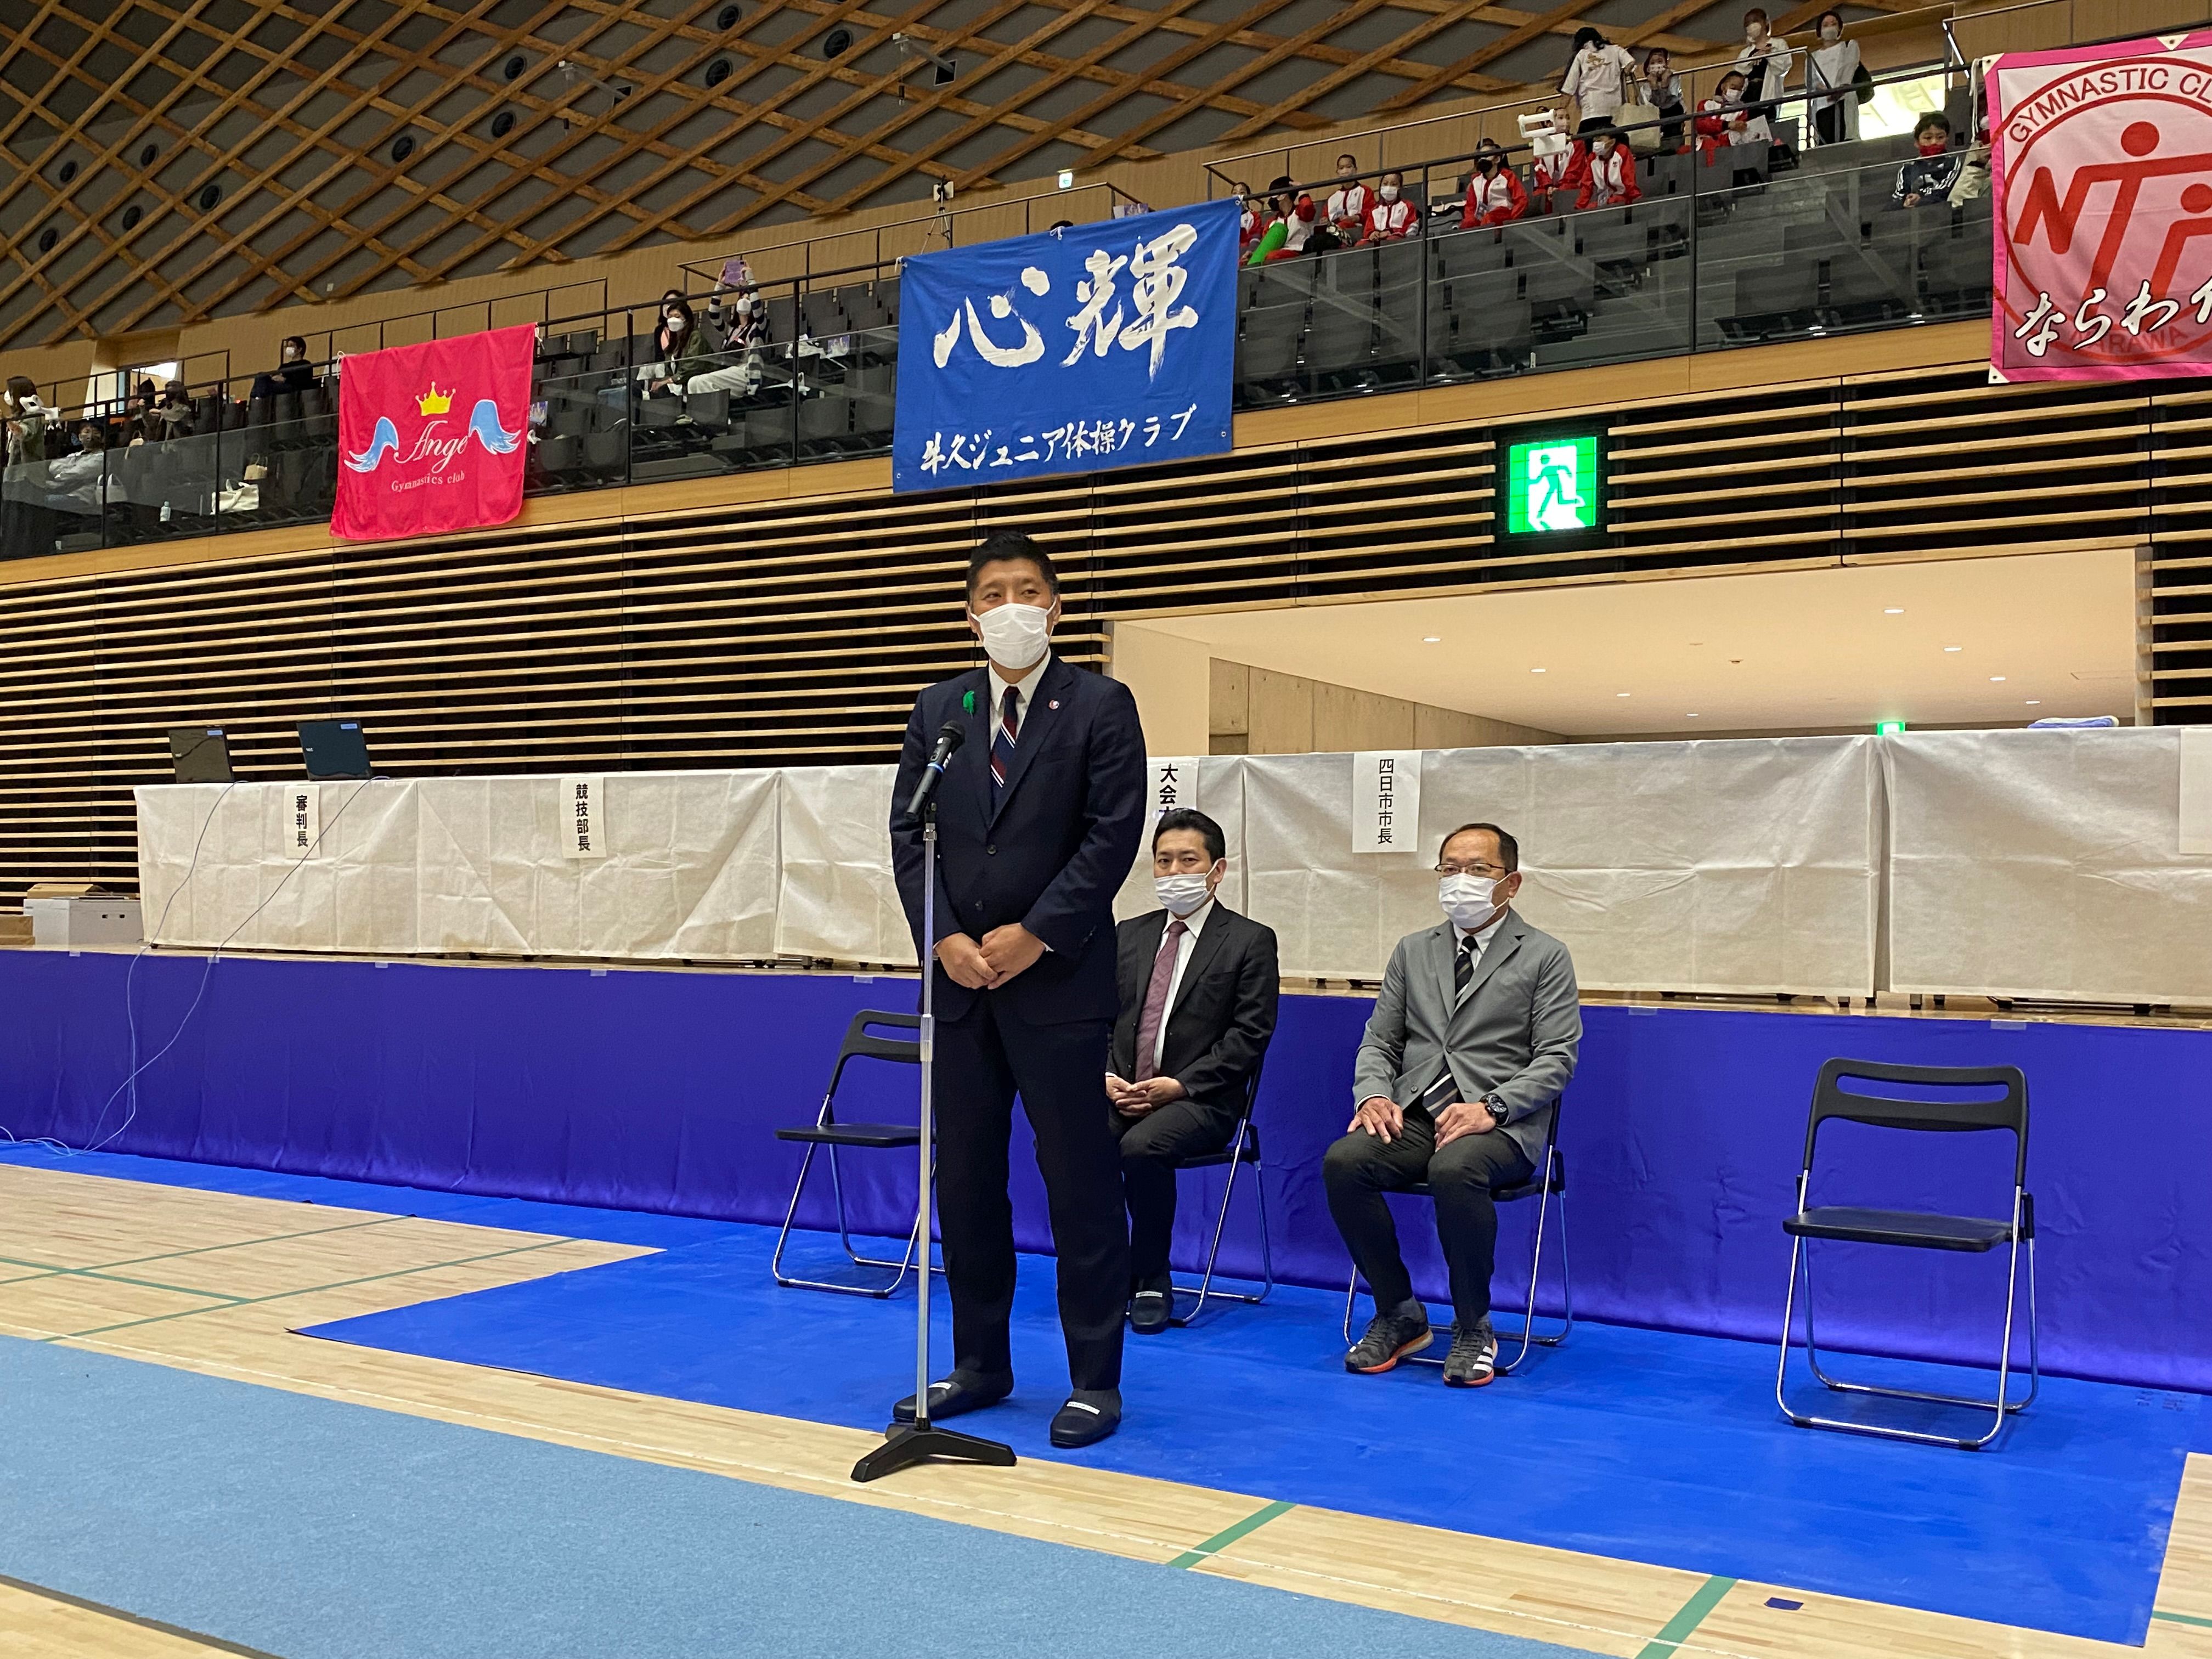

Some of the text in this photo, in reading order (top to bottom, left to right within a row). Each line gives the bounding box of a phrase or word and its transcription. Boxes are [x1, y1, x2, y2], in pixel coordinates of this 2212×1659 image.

[2009, 68, 2169, 143] GYMNASTIC
[934, 223, 1199, 383] 心輝
[921, 403, 1198, 478] 牛久ジュニア体操クラブ
[391, 470, 465, 493] Gymnastics club
[296, 794, 308, 847] 審判長
[575, 783, 591, 851] 競技部長
[1159, 763, 1178, 812] 大会
[1378, 759, 1394, 844] 四日市市長
